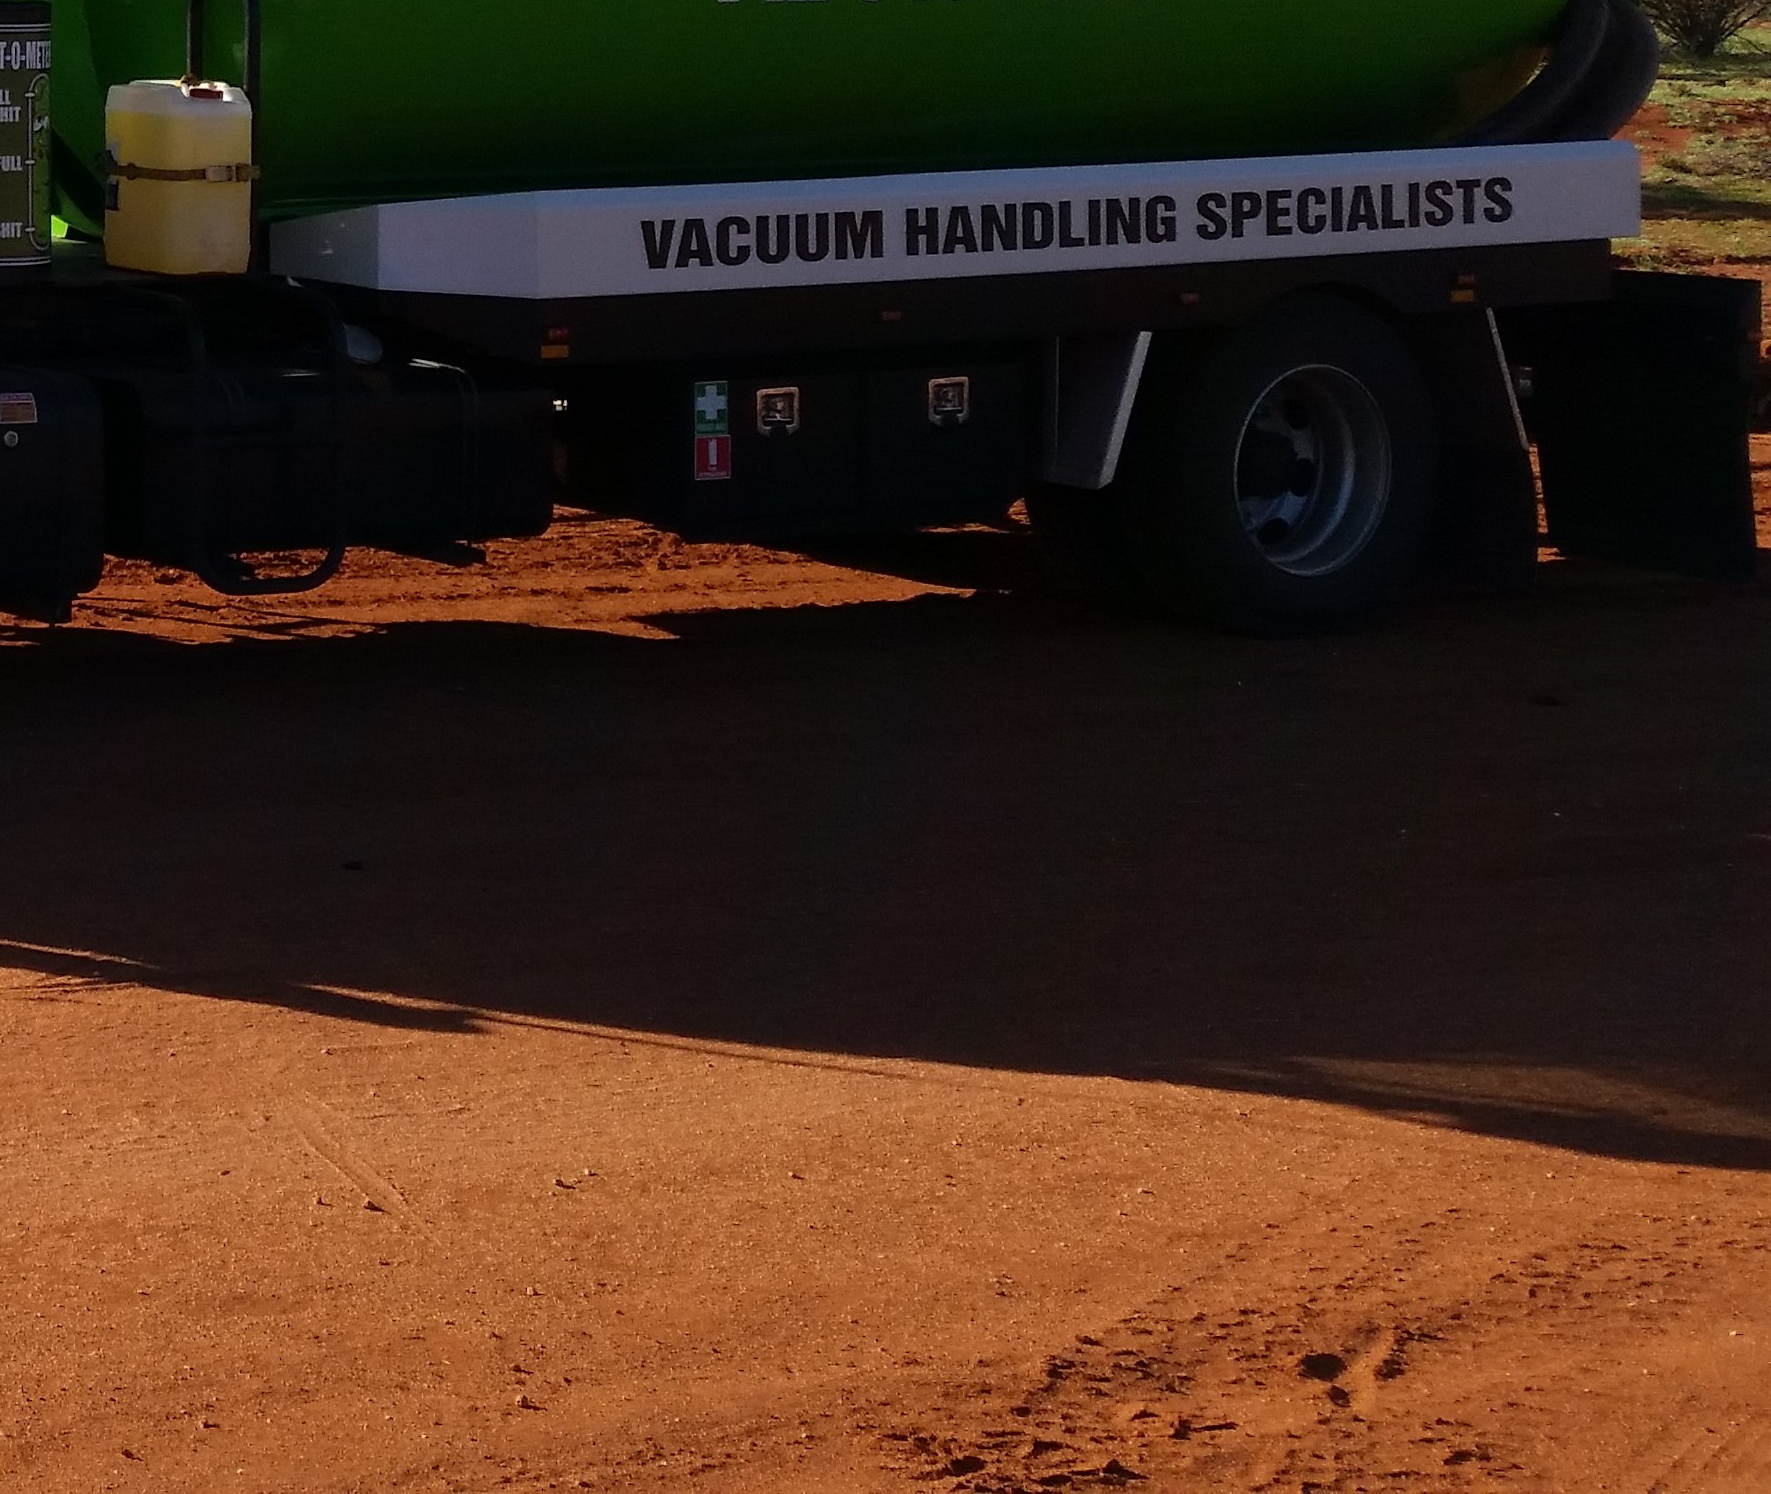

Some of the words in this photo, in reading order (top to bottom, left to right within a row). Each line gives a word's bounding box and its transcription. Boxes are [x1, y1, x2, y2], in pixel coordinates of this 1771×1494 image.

[640, 209, 884, 270] VACUUM
[905, 195, 1177, 256] HANDLING
[1195, 176, 1514, 241] SPECIALISTS
